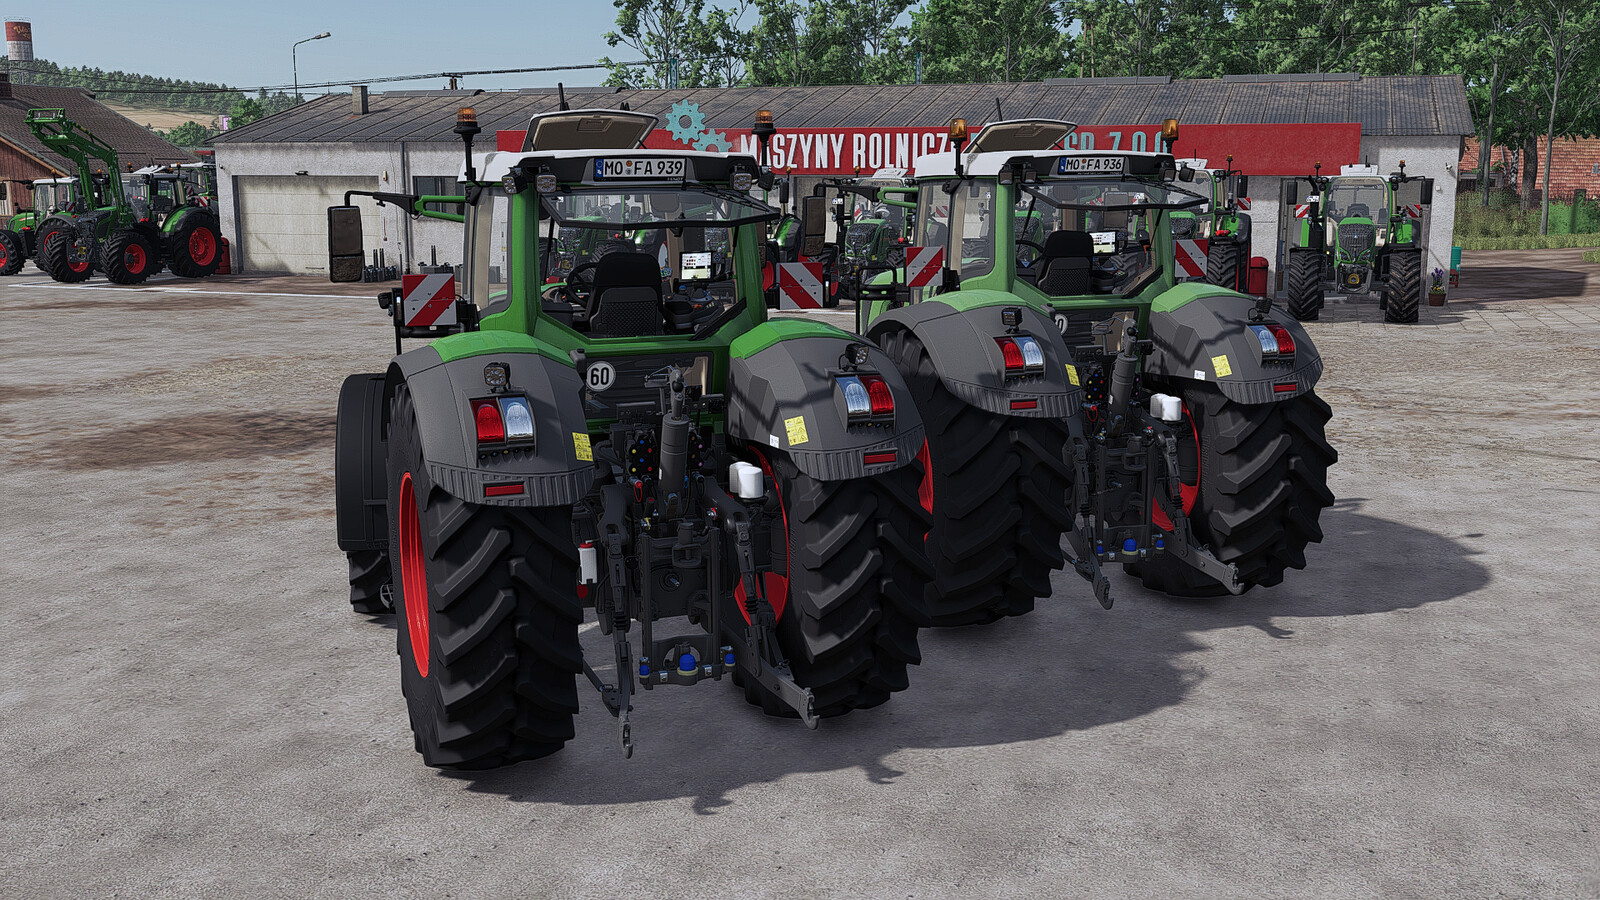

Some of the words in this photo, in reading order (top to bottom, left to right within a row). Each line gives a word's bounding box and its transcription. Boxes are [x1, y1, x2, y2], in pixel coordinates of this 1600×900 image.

[853, 133, 957, 168] ROLNICZ
[604, 161, 623, 175] MO
[634, 161, 653, 175] FA
[657, 161, 683, 175] 939
[1066, 159, 1080, 170] MO
[1087, 158, 1101, 170] FA
[1103, 158, 1122, 170] 936
[590, 366, 610, 386] 60
